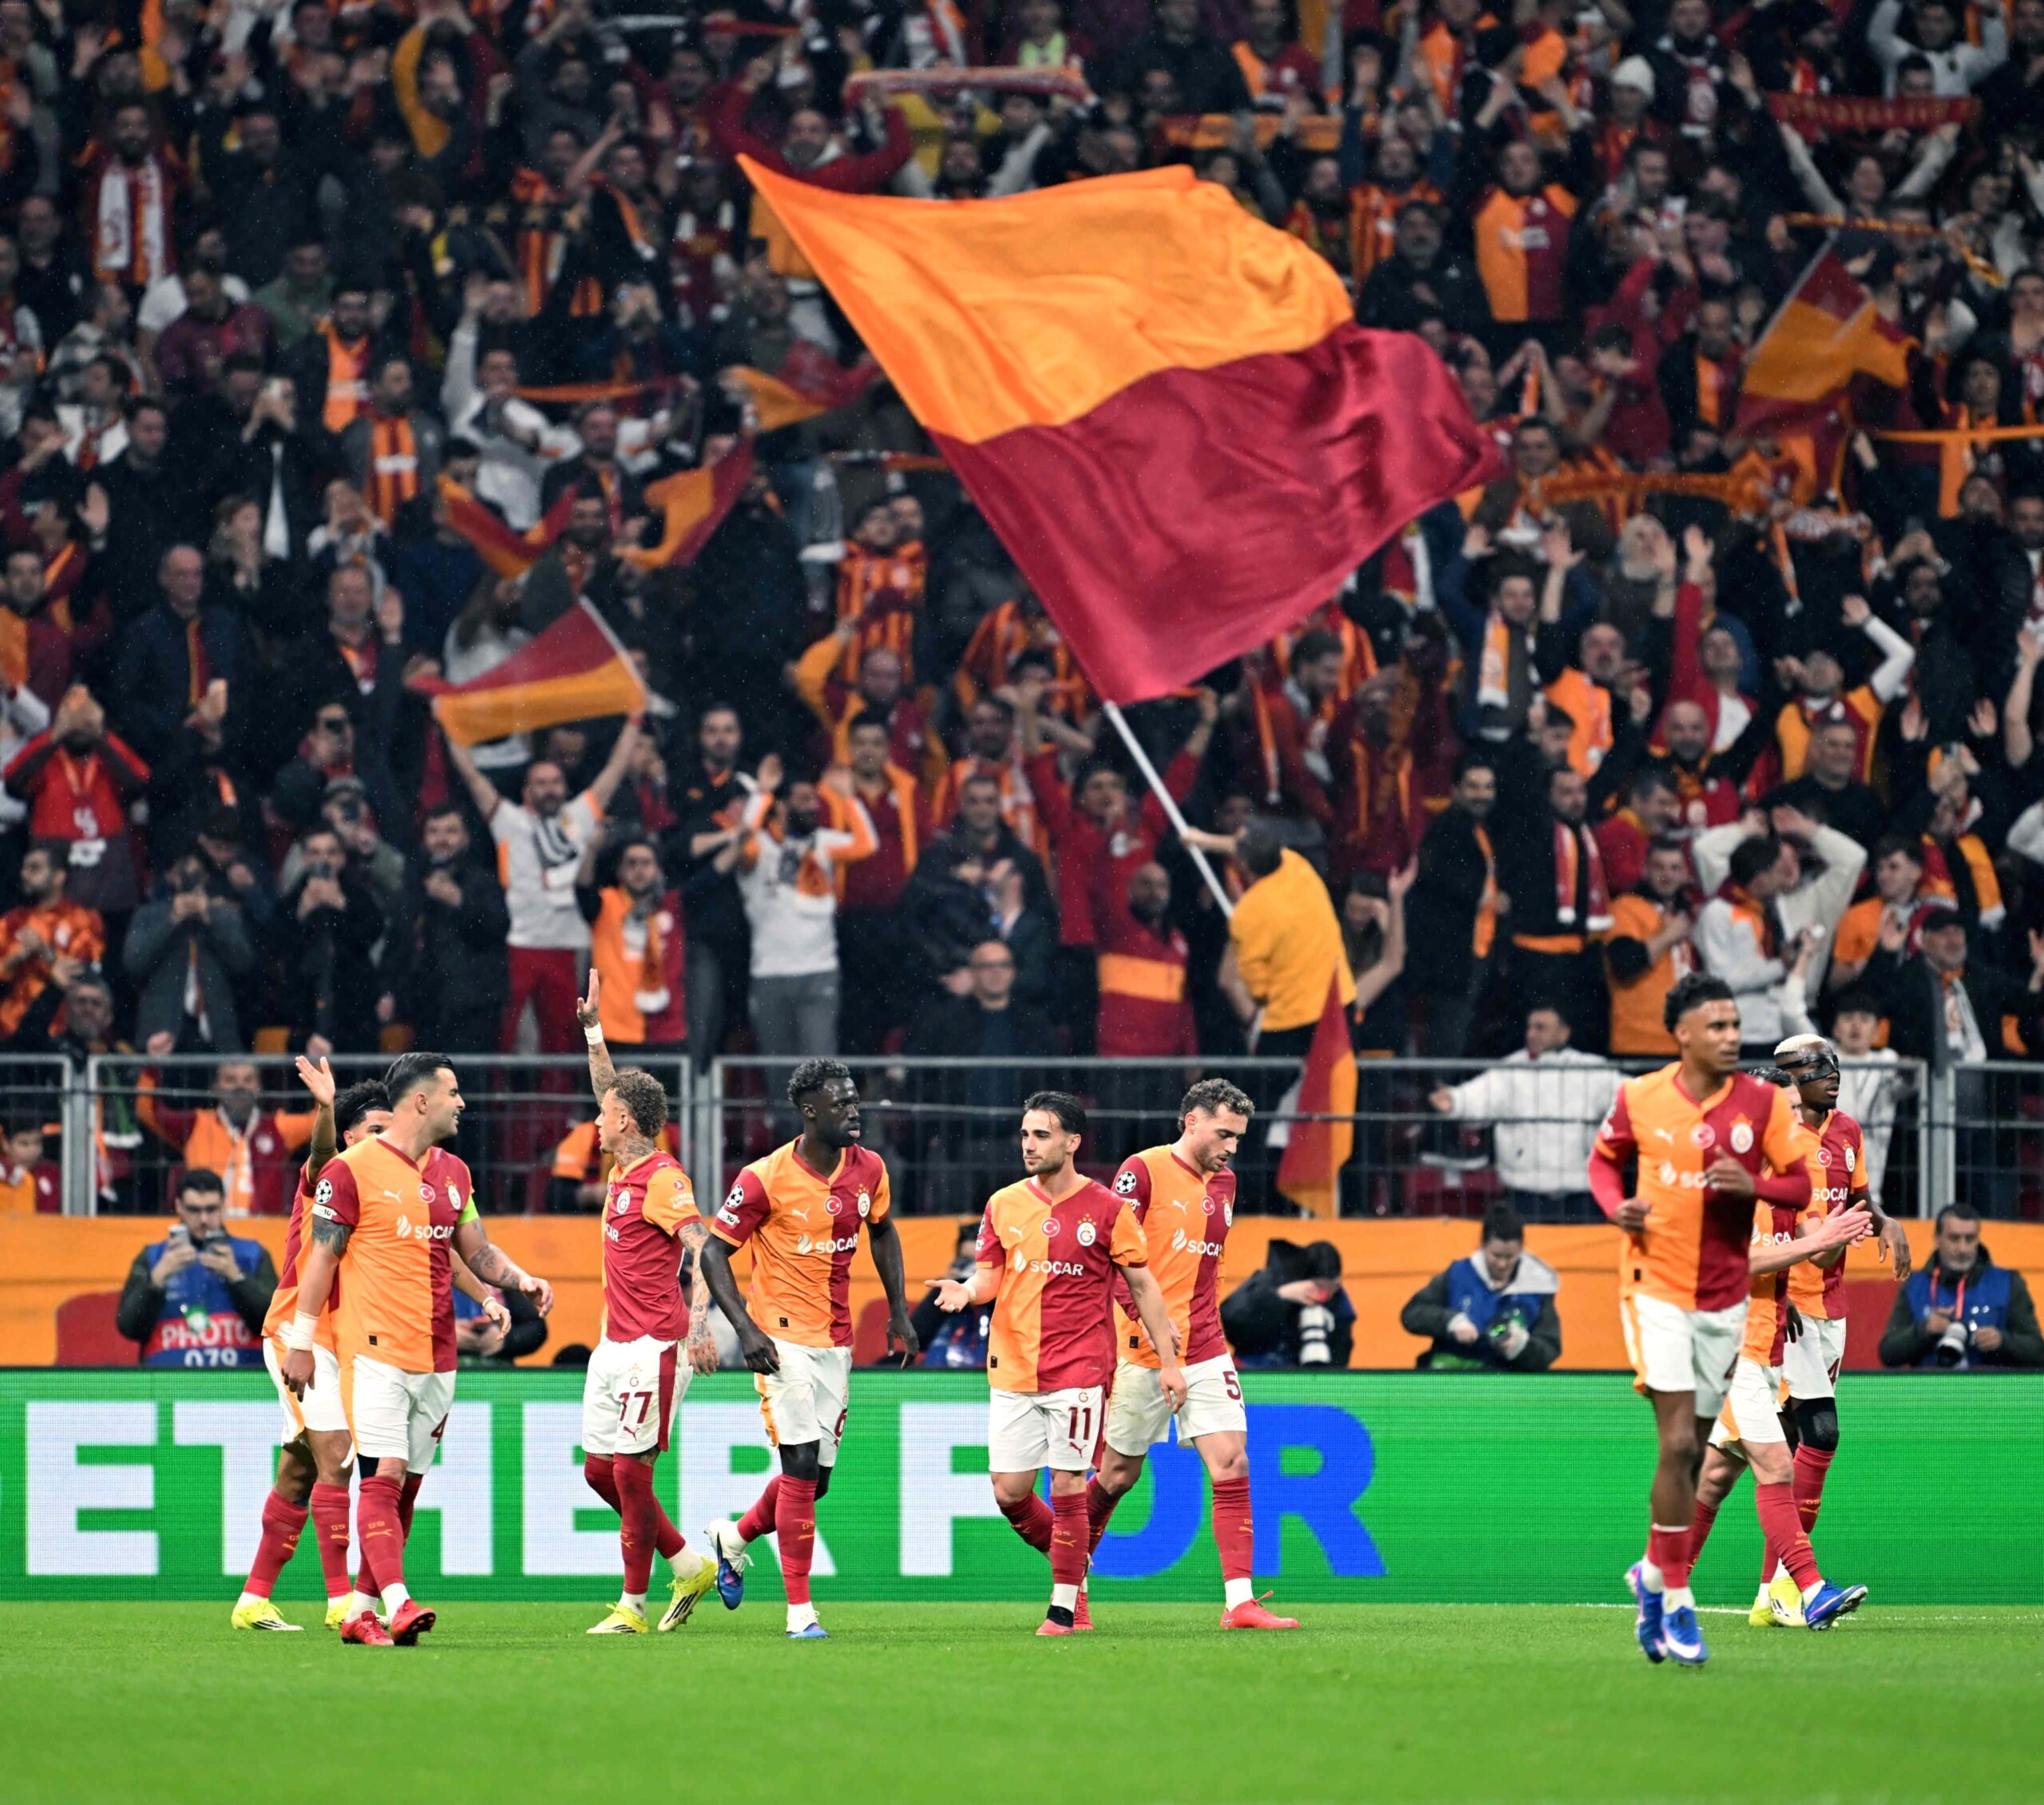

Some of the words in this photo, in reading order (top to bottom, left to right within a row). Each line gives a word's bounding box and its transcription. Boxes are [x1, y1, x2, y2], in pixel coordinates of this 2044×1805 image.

[605, 1222, 619, 1243] CAR
[815, 1233, 858, 1254] SOCAR
[1186, 1240, 1222, 1257] SOCA
[1029, 1260, 1084, 1276] SOCAR
[1222, 1371, 1241, 1400] 5
[618, 1391, 653, 1424] 17
[1068, 1407, 1091, 1440] 11
[0, 1401, 837, 1575] ETHER
[899, 1403, 1388, 1579] FOR
